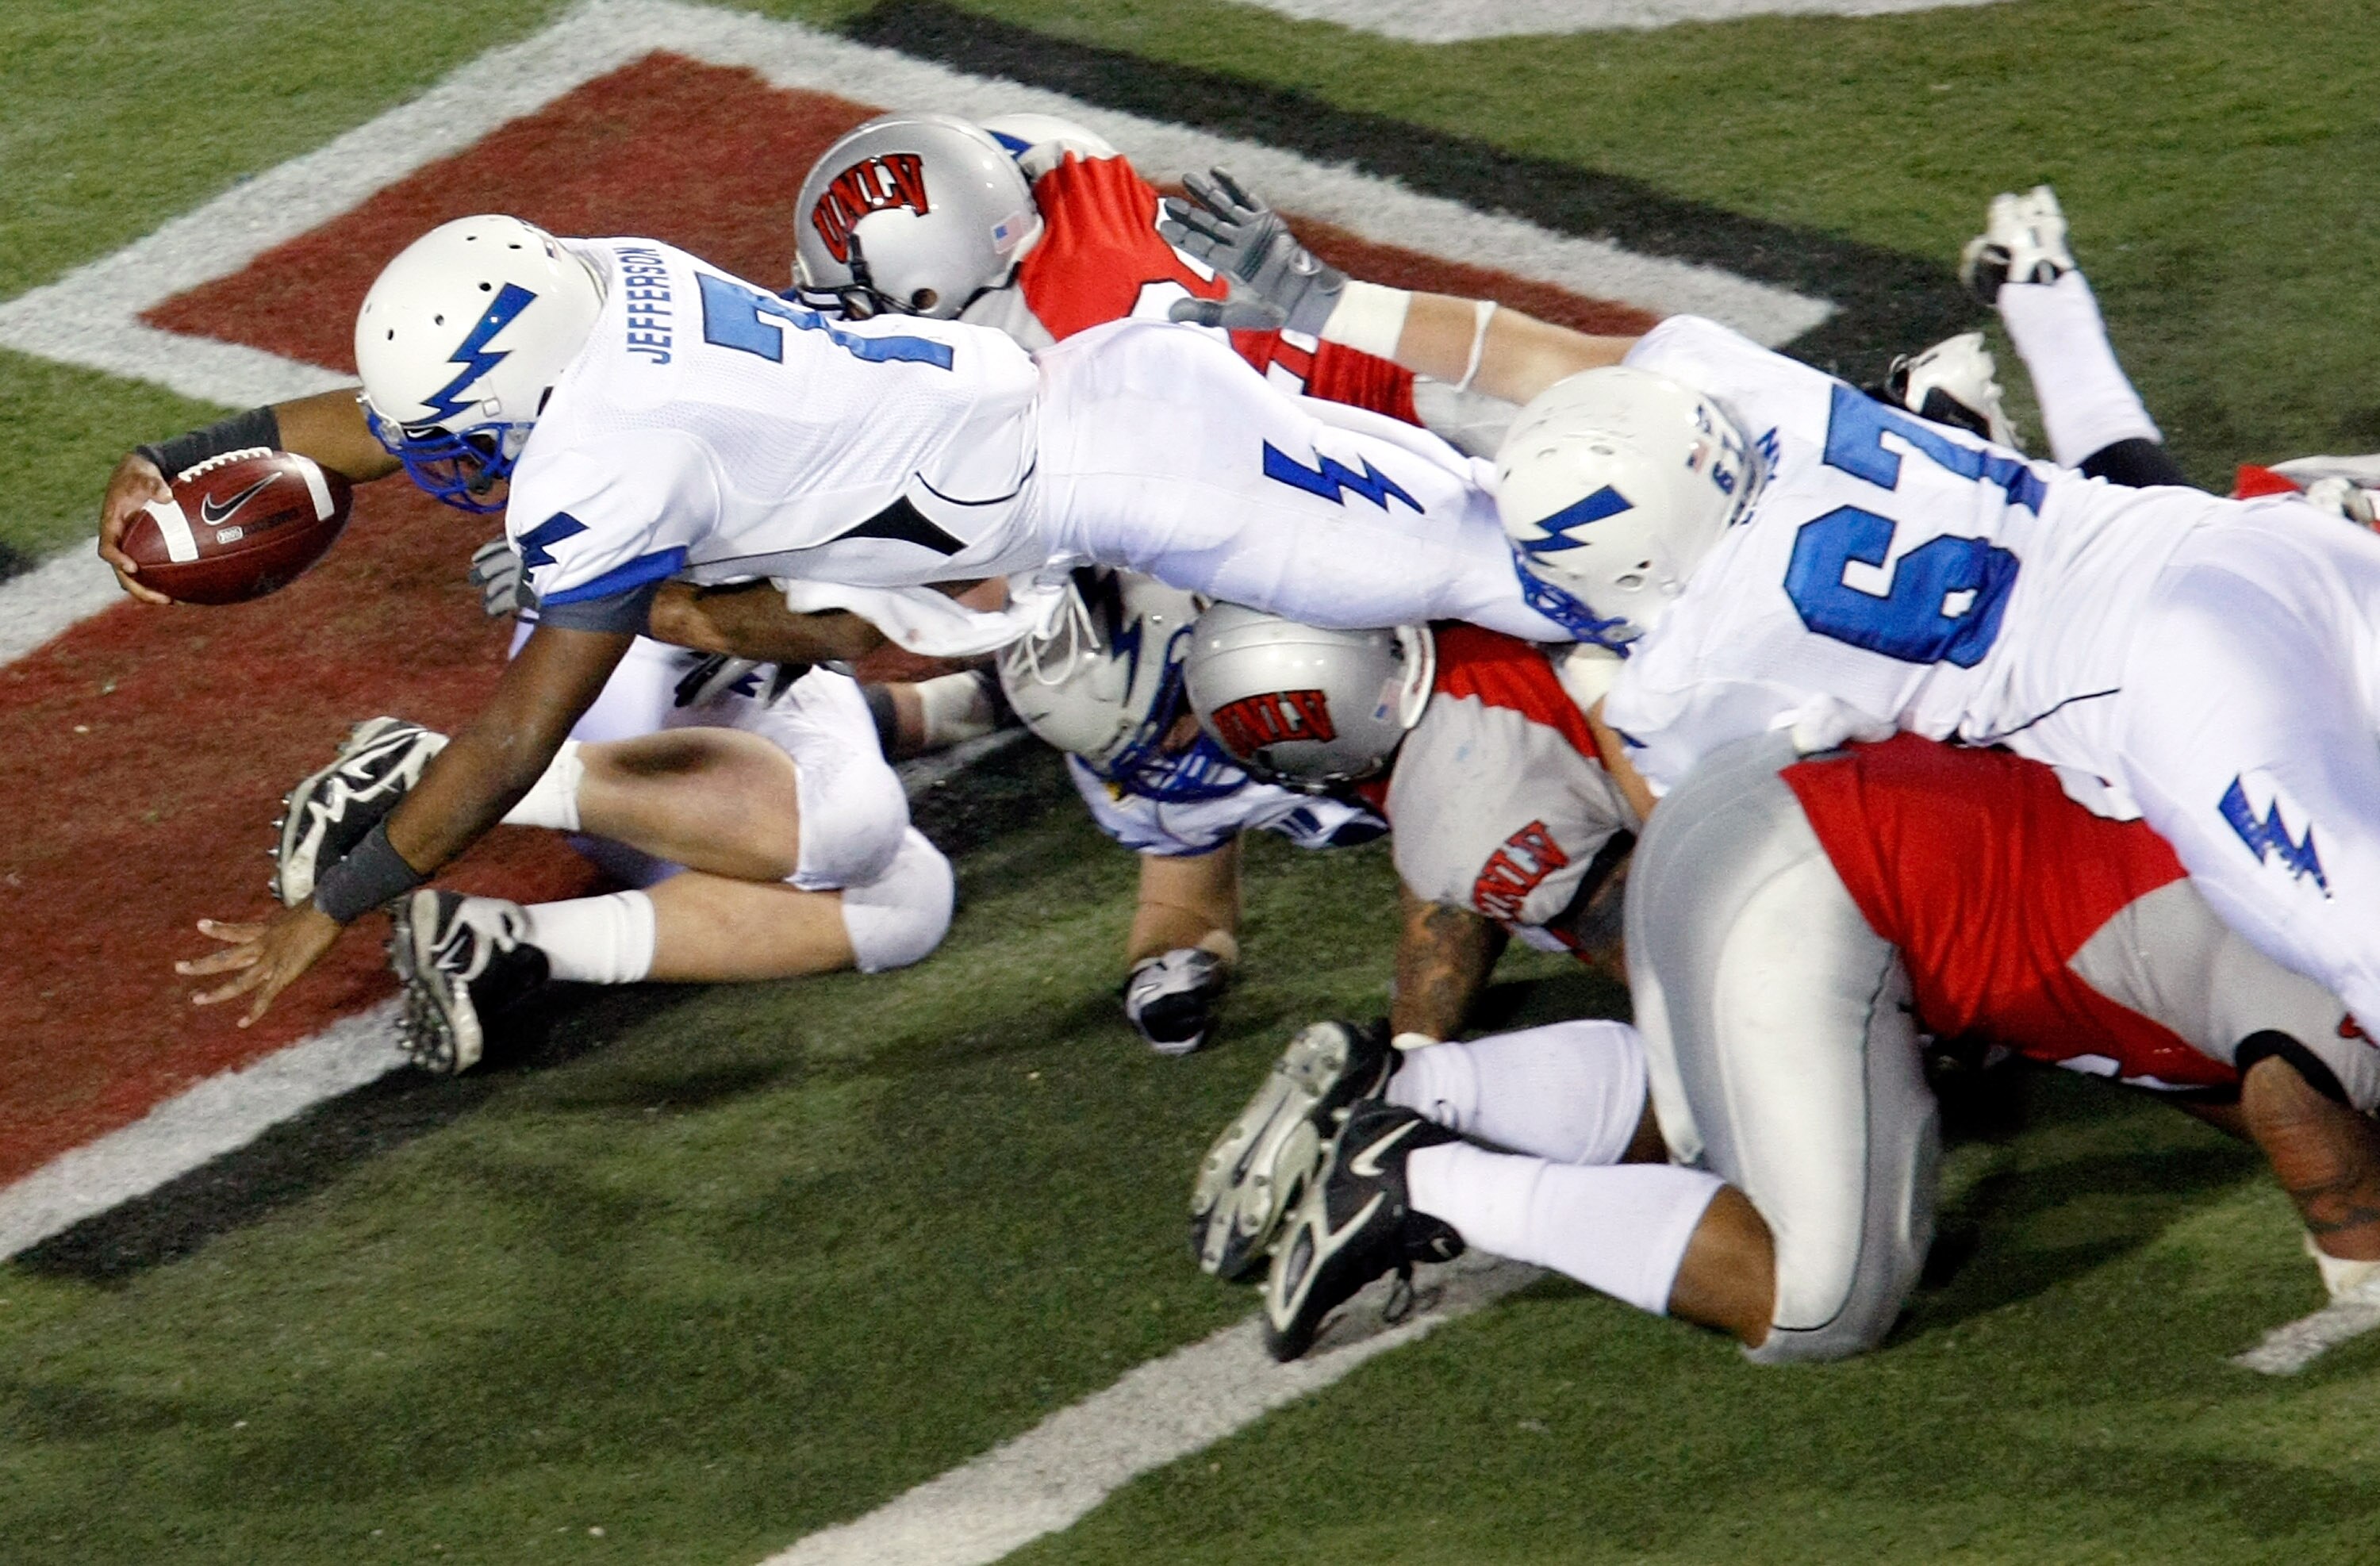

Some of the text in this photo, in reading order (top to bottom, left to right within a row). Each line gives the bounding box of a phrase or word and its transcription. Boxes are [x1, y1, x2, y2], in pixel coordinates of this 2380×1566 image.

[812, 153, 931, 264] UNLV
[613, 247, 672, 364] JEFFERSON
[1784, 384, 2048, 669] 67
[1211, 689, 1339, 760] UNLV
